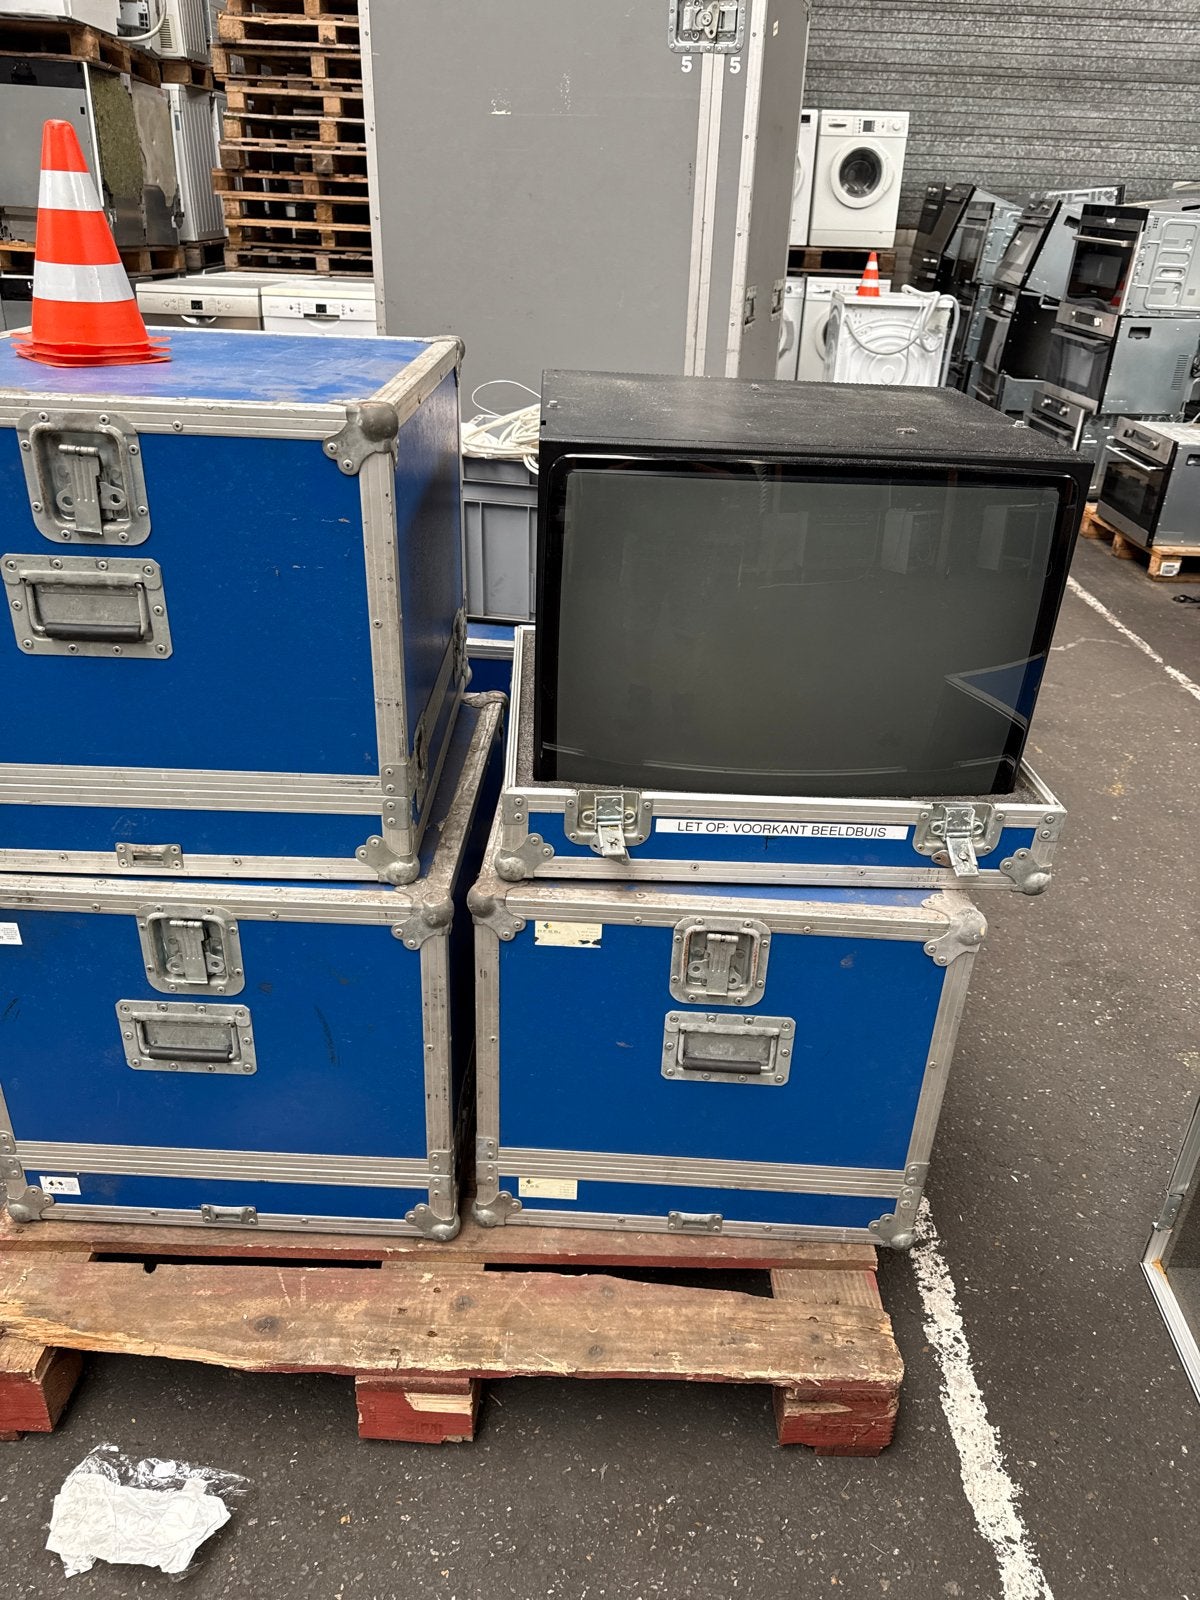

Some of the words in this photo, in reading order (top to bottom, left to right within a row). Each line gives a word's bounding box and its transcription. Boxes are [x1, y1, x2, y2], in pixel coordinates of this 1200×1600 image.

[681, 56, 693, 73] 5
[729, 57, 741, 74] 5
[677, 821, 703, 832] LET
[706, 822, 728, 833] OP:
[733, 823, 809, 835] VOORKANT
[811, 825, 887, 838] BEELDBUIS
